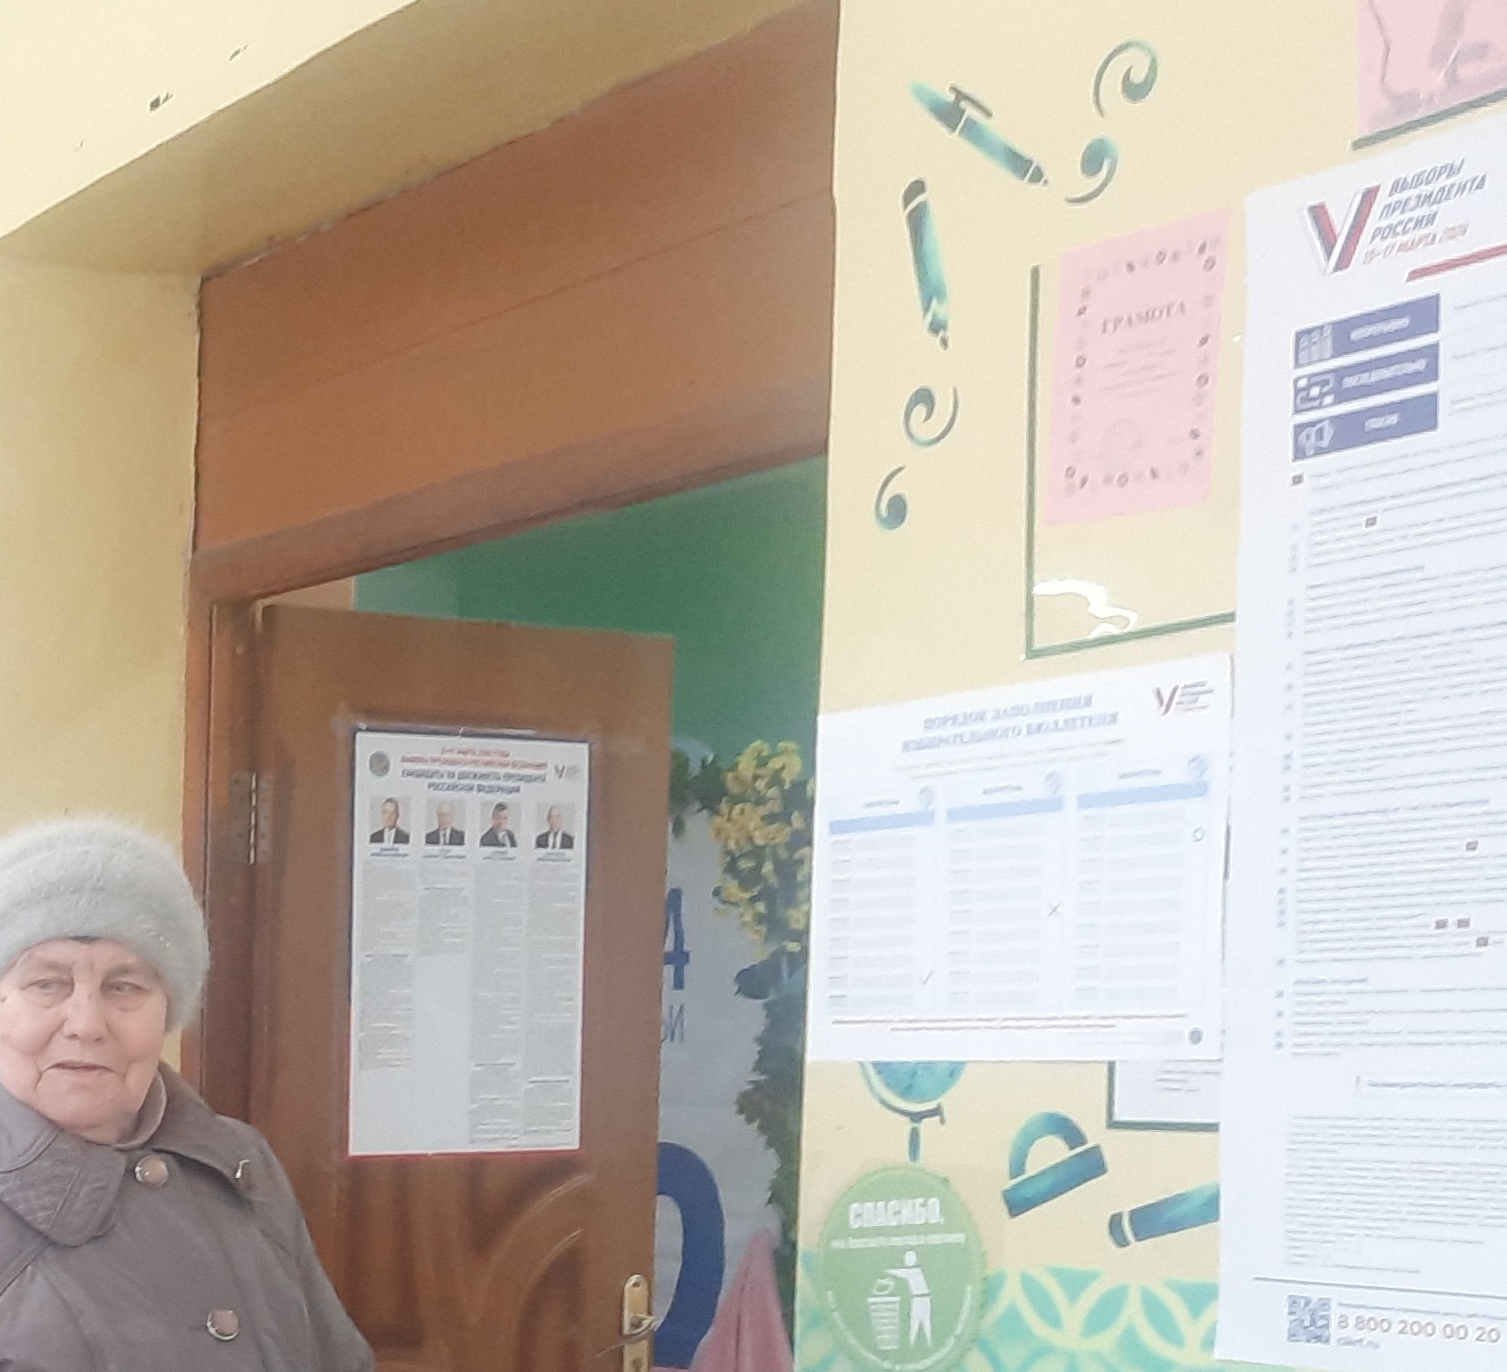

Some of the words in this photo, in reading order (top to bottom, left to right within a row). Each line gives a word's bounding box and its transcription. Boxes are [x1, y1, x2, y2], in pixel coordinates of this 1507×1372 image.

[1388, 158, 1465, 197] ВЫБОРЫ
[1378, 174, 1487, 220] ПРЕЗИДЕНТА
[1369, 210, 1439, 244] РОССИИ
[1101, 300, 1186, 334] ГРАМОТА
[1337, 1314, 1349, 1329] 8
[1354, 1315, 1392, 1333] 800
[1398, 1319, 1436, 1337] 200
[1443, 1323, 1469, 1340] 00
[1474, 1326, 1501, 1344] 20
